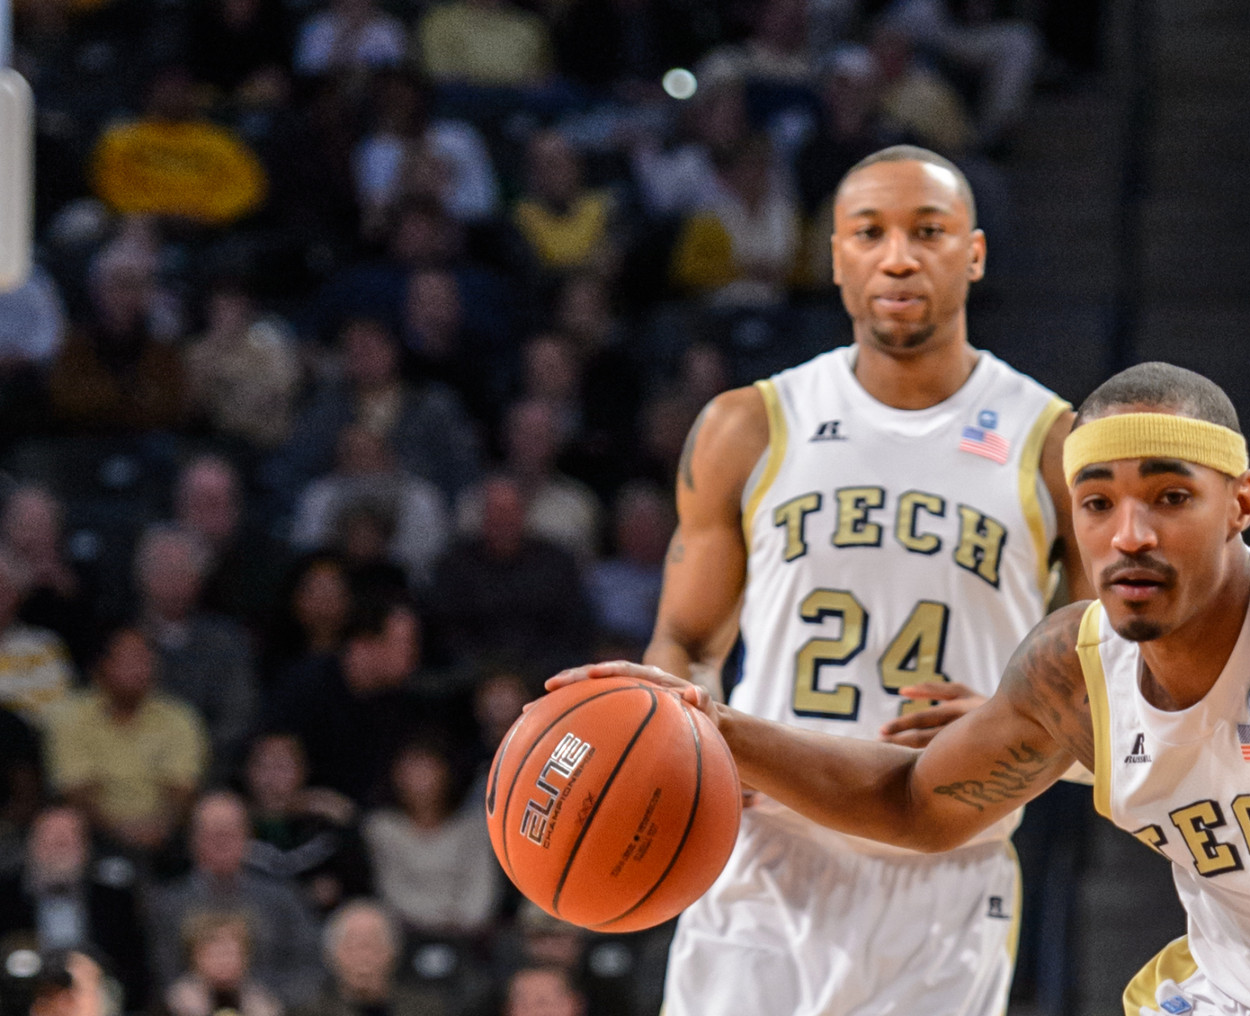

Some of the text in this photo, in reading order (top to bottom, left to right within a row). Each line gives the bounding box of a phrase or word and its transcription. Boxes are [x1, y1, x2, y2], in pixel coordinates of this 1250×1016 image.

[774, 486, 1008, 590] TECH
[793, 587, 950, 722] 24
[520, 732, 591, 846] ELITE
